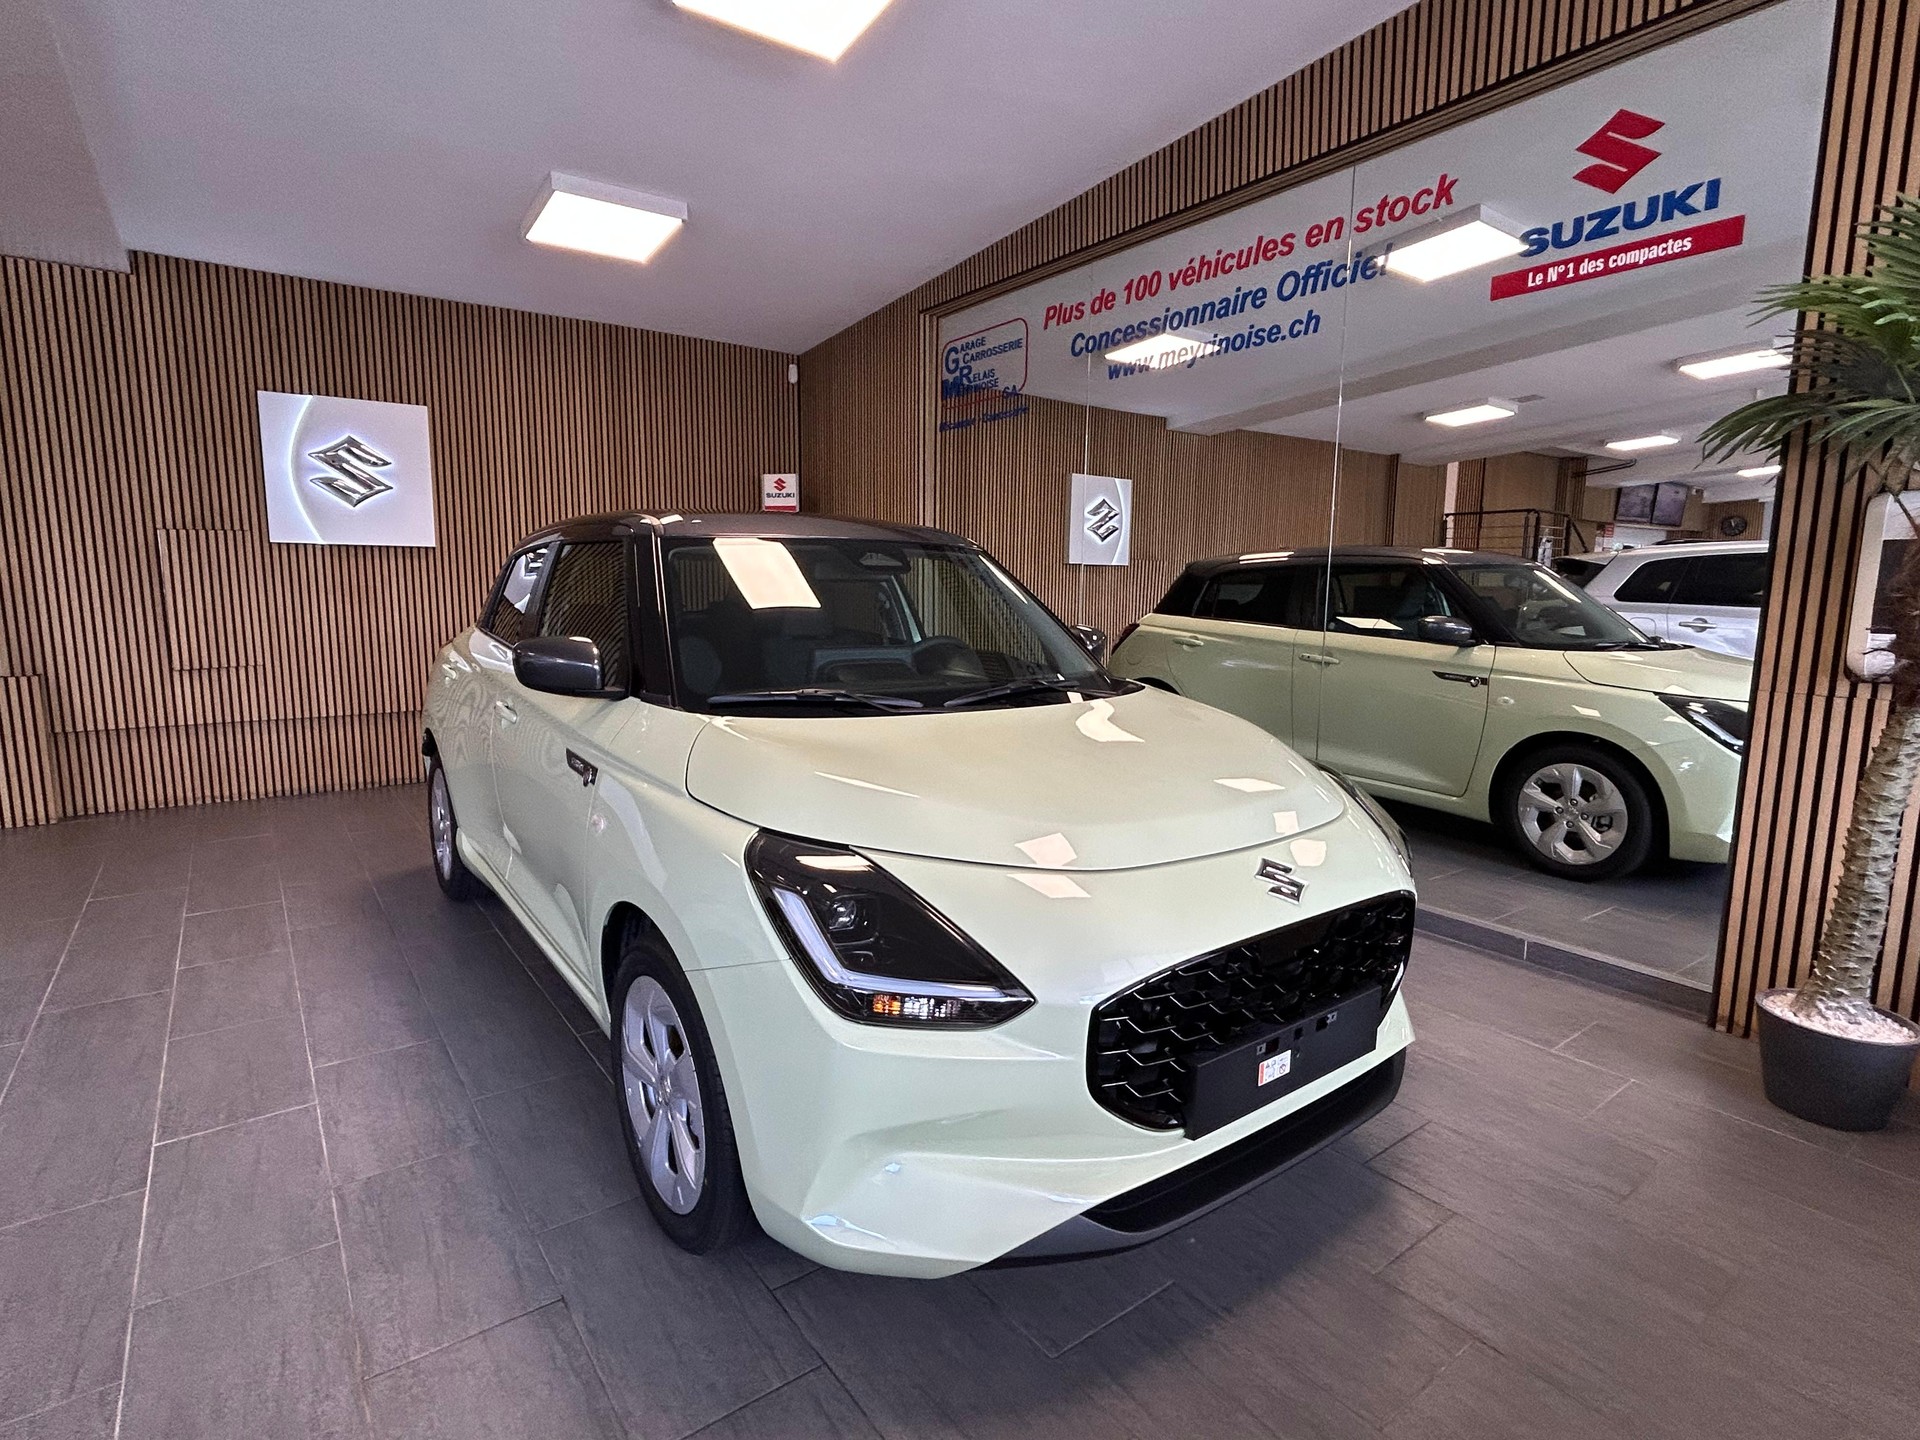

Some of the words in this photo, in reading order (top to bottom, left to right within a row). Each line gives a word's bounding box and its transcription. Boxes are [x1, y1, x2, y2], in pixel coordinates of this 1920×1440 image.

[1043, 300, 1085, 330] Plus
[1090, 288, 1116, 315] de
[1124, 270, 1161, 305] 100
[1168, 230, 1295, 287] véhicules
[1305, 216, 1345, 248] en
[1354, 173, 1460, 233] stock
[1520, 177, 1721, 257] SUZUKI
[1527, 272, 1543, 287] Le
[1579, 256, 1604, 275] des
[1608, 235, 1693, 268] compactes
[963, 338, 1023, 365] CARROSSERIE
[1071, 284, 1267, 358] Concessionnaire
[1107, 309, 1322, 381] www.meyrinoise.ch
[960, 365, 996, 384] RELAIS
